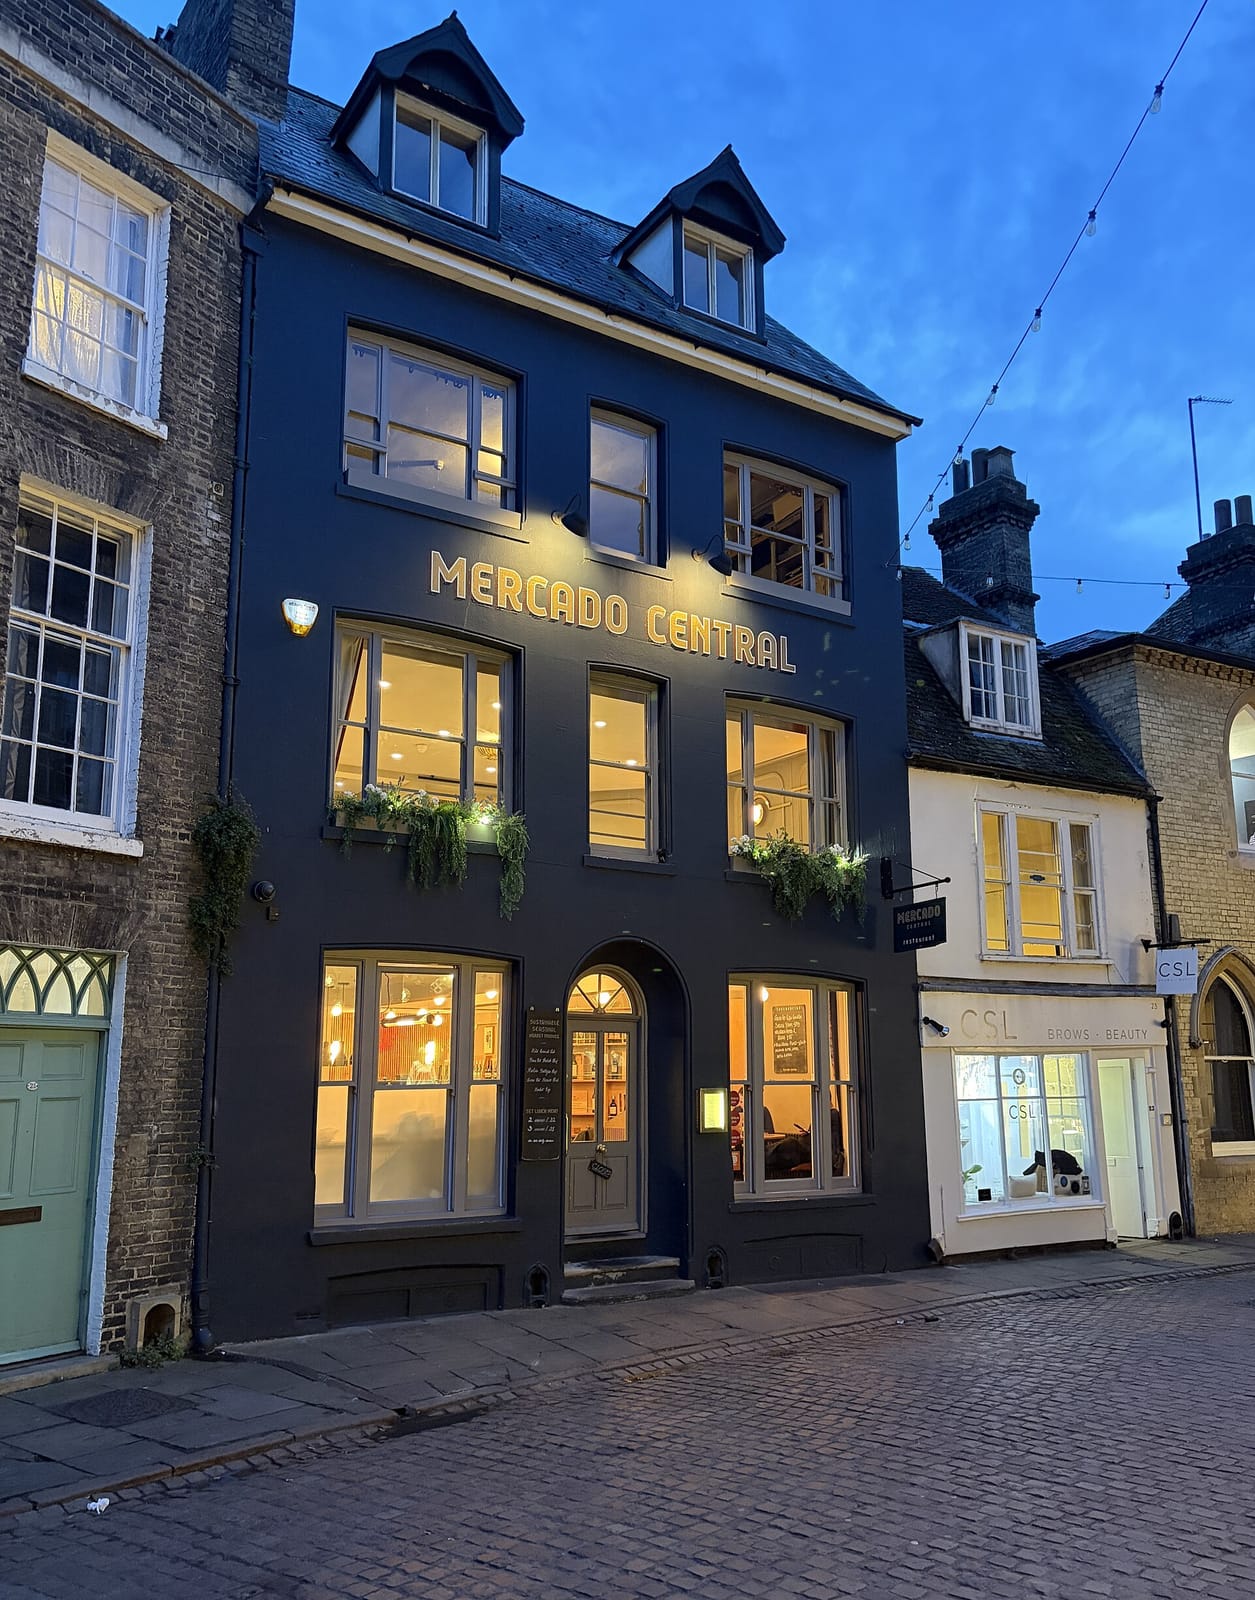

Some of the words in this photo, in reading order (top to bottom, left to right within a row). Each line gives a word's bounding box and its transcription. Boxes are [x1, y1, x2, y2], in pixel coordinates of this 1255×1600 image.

[430, 550, 628, 635] MERCADO
[647, 604, 797, 674] CENTRAL
[897, 905, 940, 925] MERCADO
[1159, 961, 1196, 978] CSL
[960, 1009, 1018, 1040] CSL
[1047, 1028, 1089, 1040] BROWS
[1106, 1028, 1148, 1040] BEAUTY
[1009, 1104, 1036, 1119] CSL
